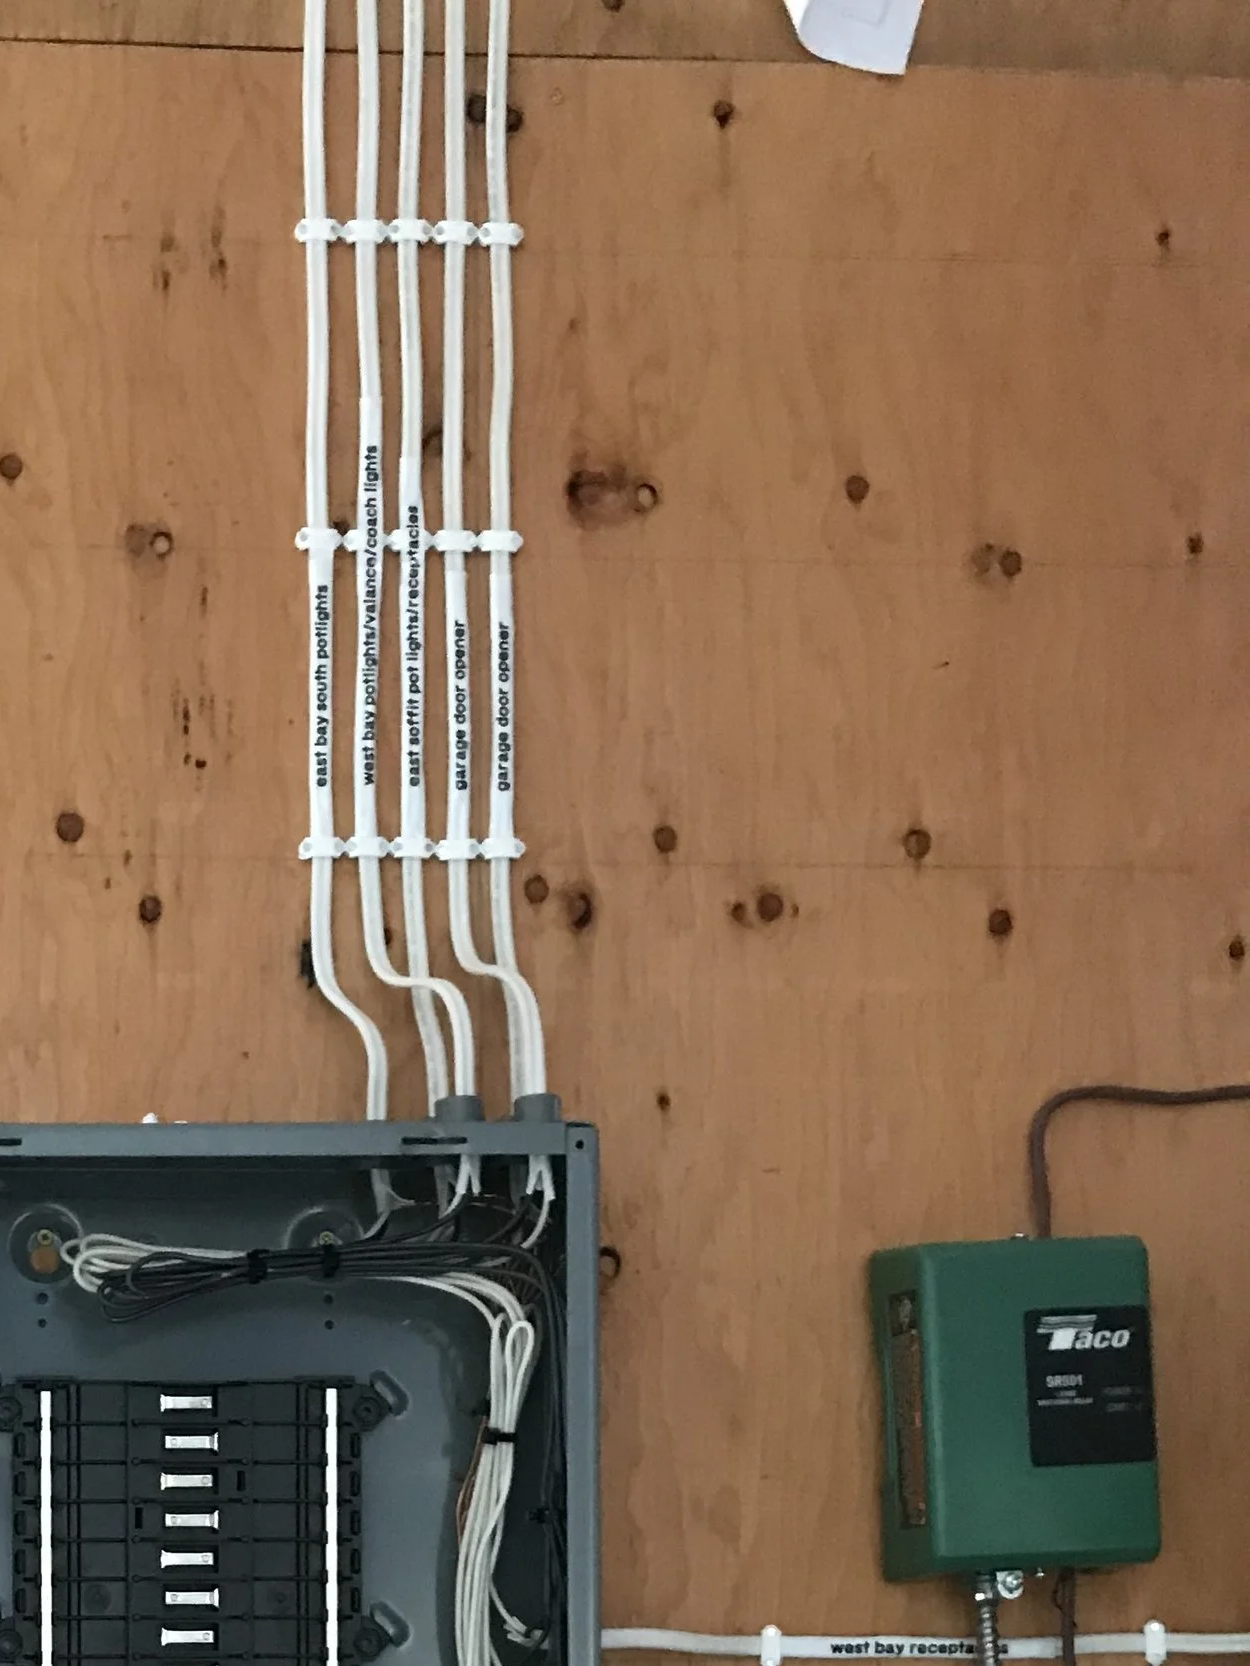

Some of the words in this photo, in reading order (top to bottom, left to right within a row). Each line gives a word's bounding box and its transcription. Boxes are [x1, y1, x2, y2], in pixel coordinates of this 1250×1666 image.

[364, 444, 379, 492] lights
[363, 498, 380, 708] potlights/valance/coach
[406, 504, 421, 661] lights/receptacles
[315, 585, 330, 659] potlights
[455, 621, 466, 679] opener
[499, 623, 510, 682] opener
[315, 665, 327, 711] south
[407, 666, 421, 694] pot
[407, 700, 421, 744] soffit
[454, 685, 466, 724] door
[496, 688, 509, 727] door
[315, 716, 329, 746] bay
[364, 713, 377, 745] bay
[315, 752, 327, 787] east
[363, 748, 376, 785] west
[409, 746, 421, 787] east
[456, 730, 469, 790] garage
[498, 732, 511, 791] garage
[1036, 1314, 1130, 1351] Taco
[831, 1641, 869, 1653] west
[875, 1641, 905, 1656] bay
[909, 1641, 1009, 1655] receptas
